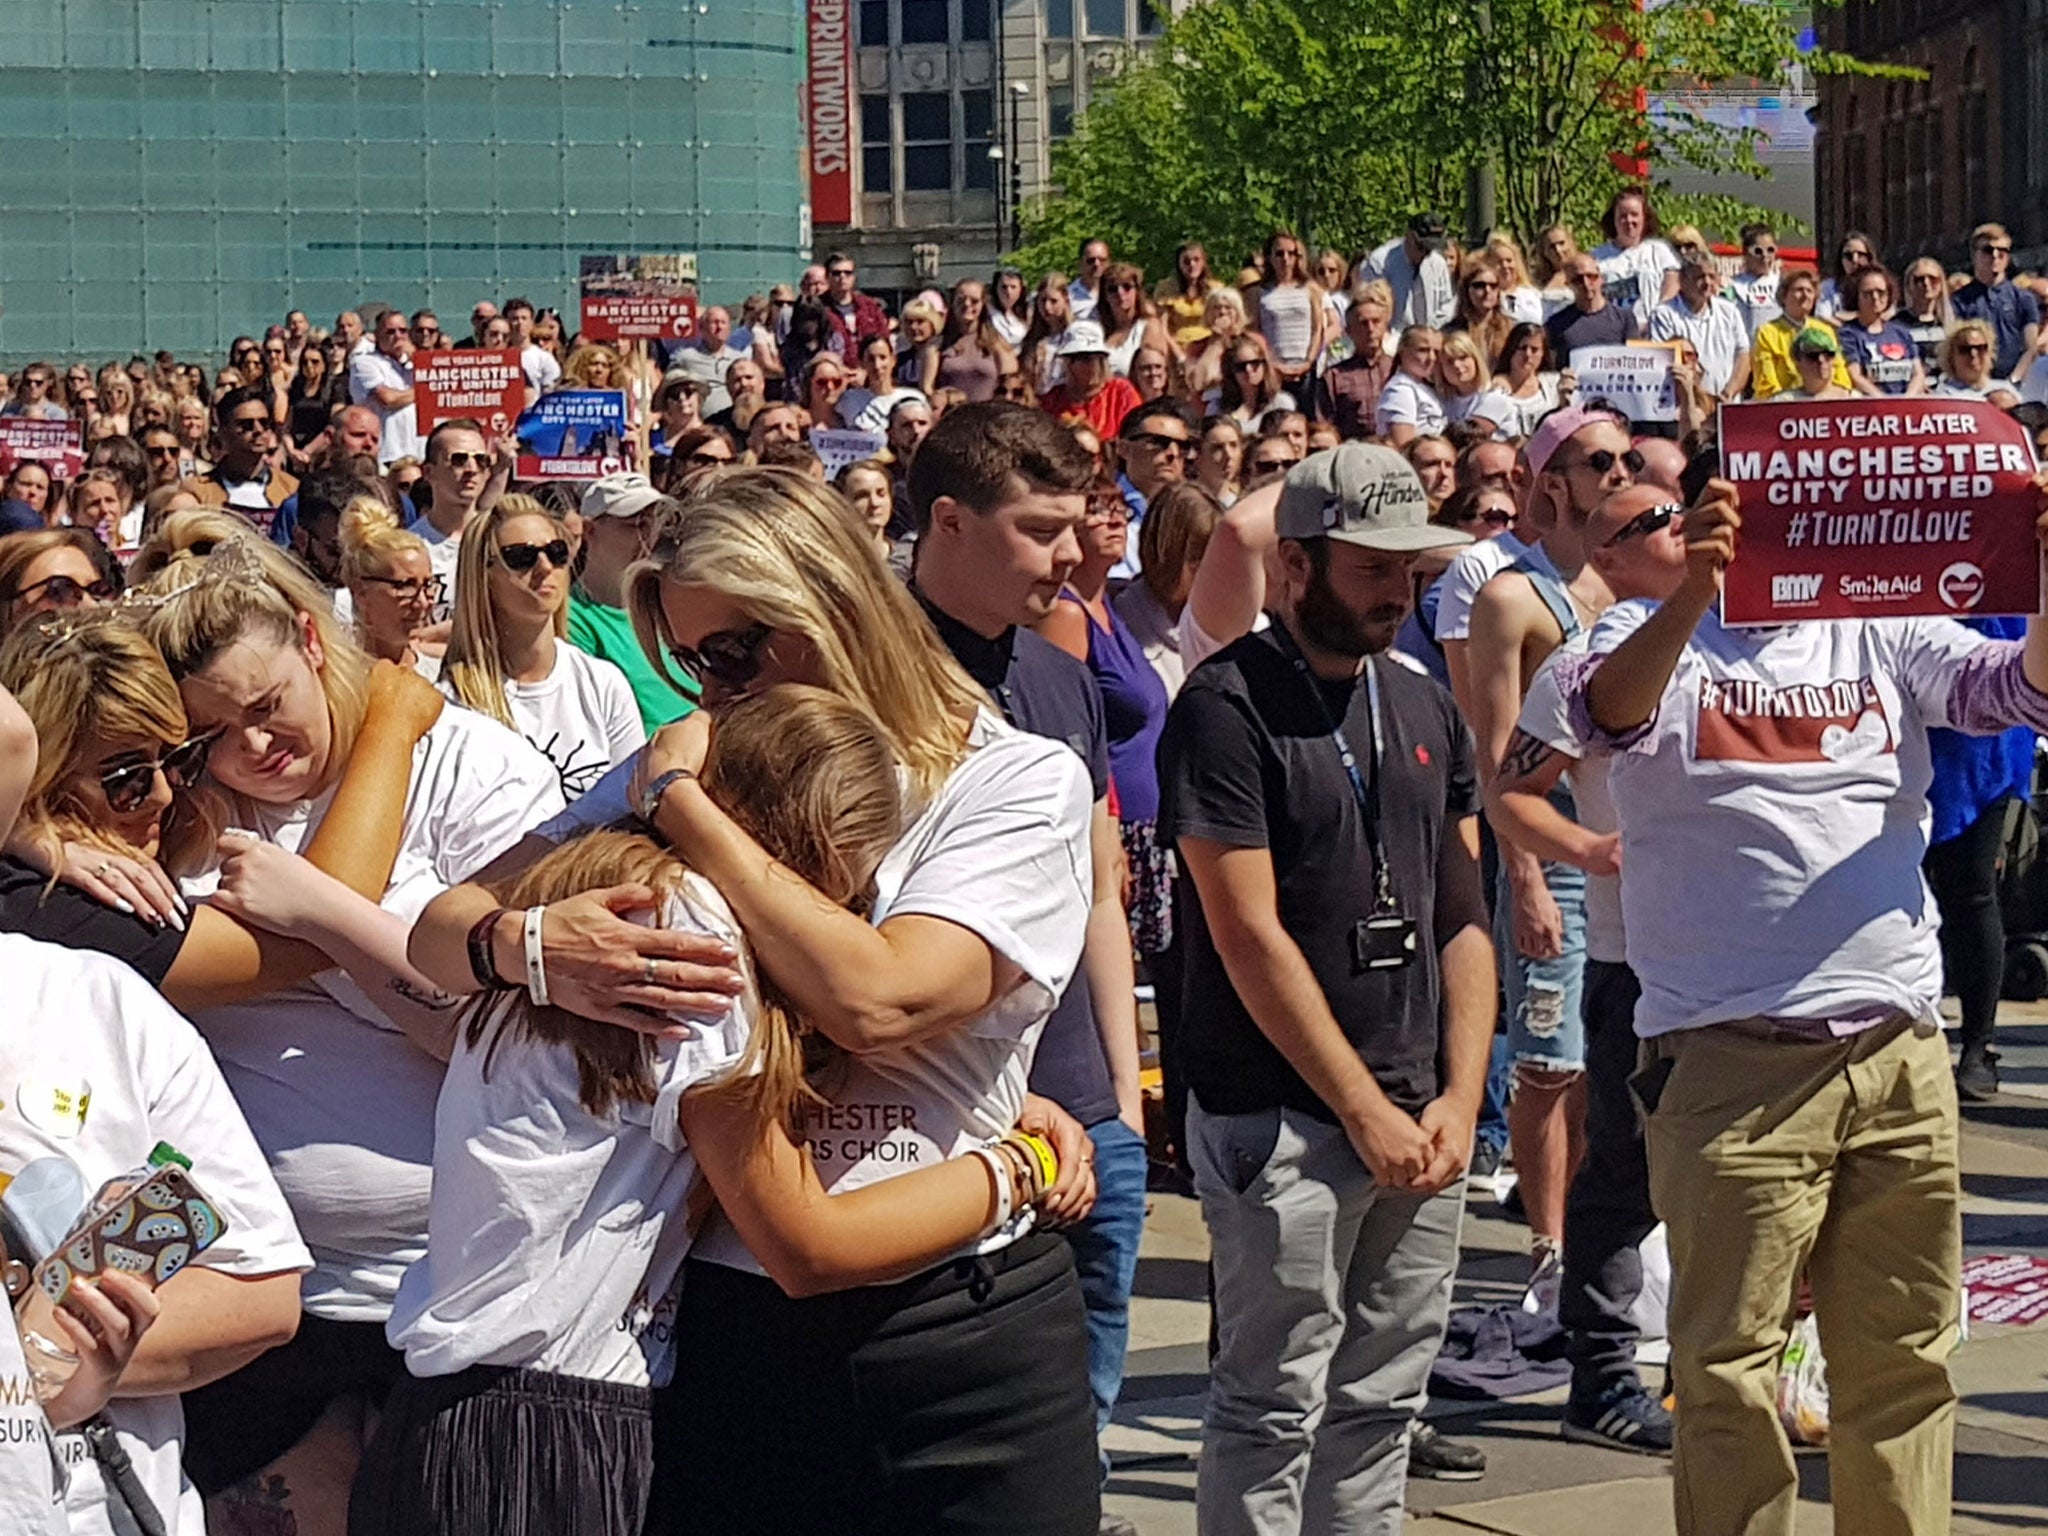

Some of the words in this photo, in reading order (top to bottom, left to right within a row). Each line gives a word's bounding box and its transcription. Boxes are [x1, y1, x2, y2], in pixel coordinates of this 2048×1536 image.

[415, 366, 519, 381] MANCHESTER
[429, 381, 458, 391] CITY
[462, 379, 508, 390] UNITED
[1780, 417, 1830, 440] ONE
[1836, 415, 1900, 437] YEAR
[1905, 413, 1978, 435] LATER
[1728, 443, 2028, 481] MANCHESTER
[1768, 479, 1849, 505] CITY
[1864, 475, 1994, 501] UNITED
[841, 1140, 920, 1162] CHOIR
